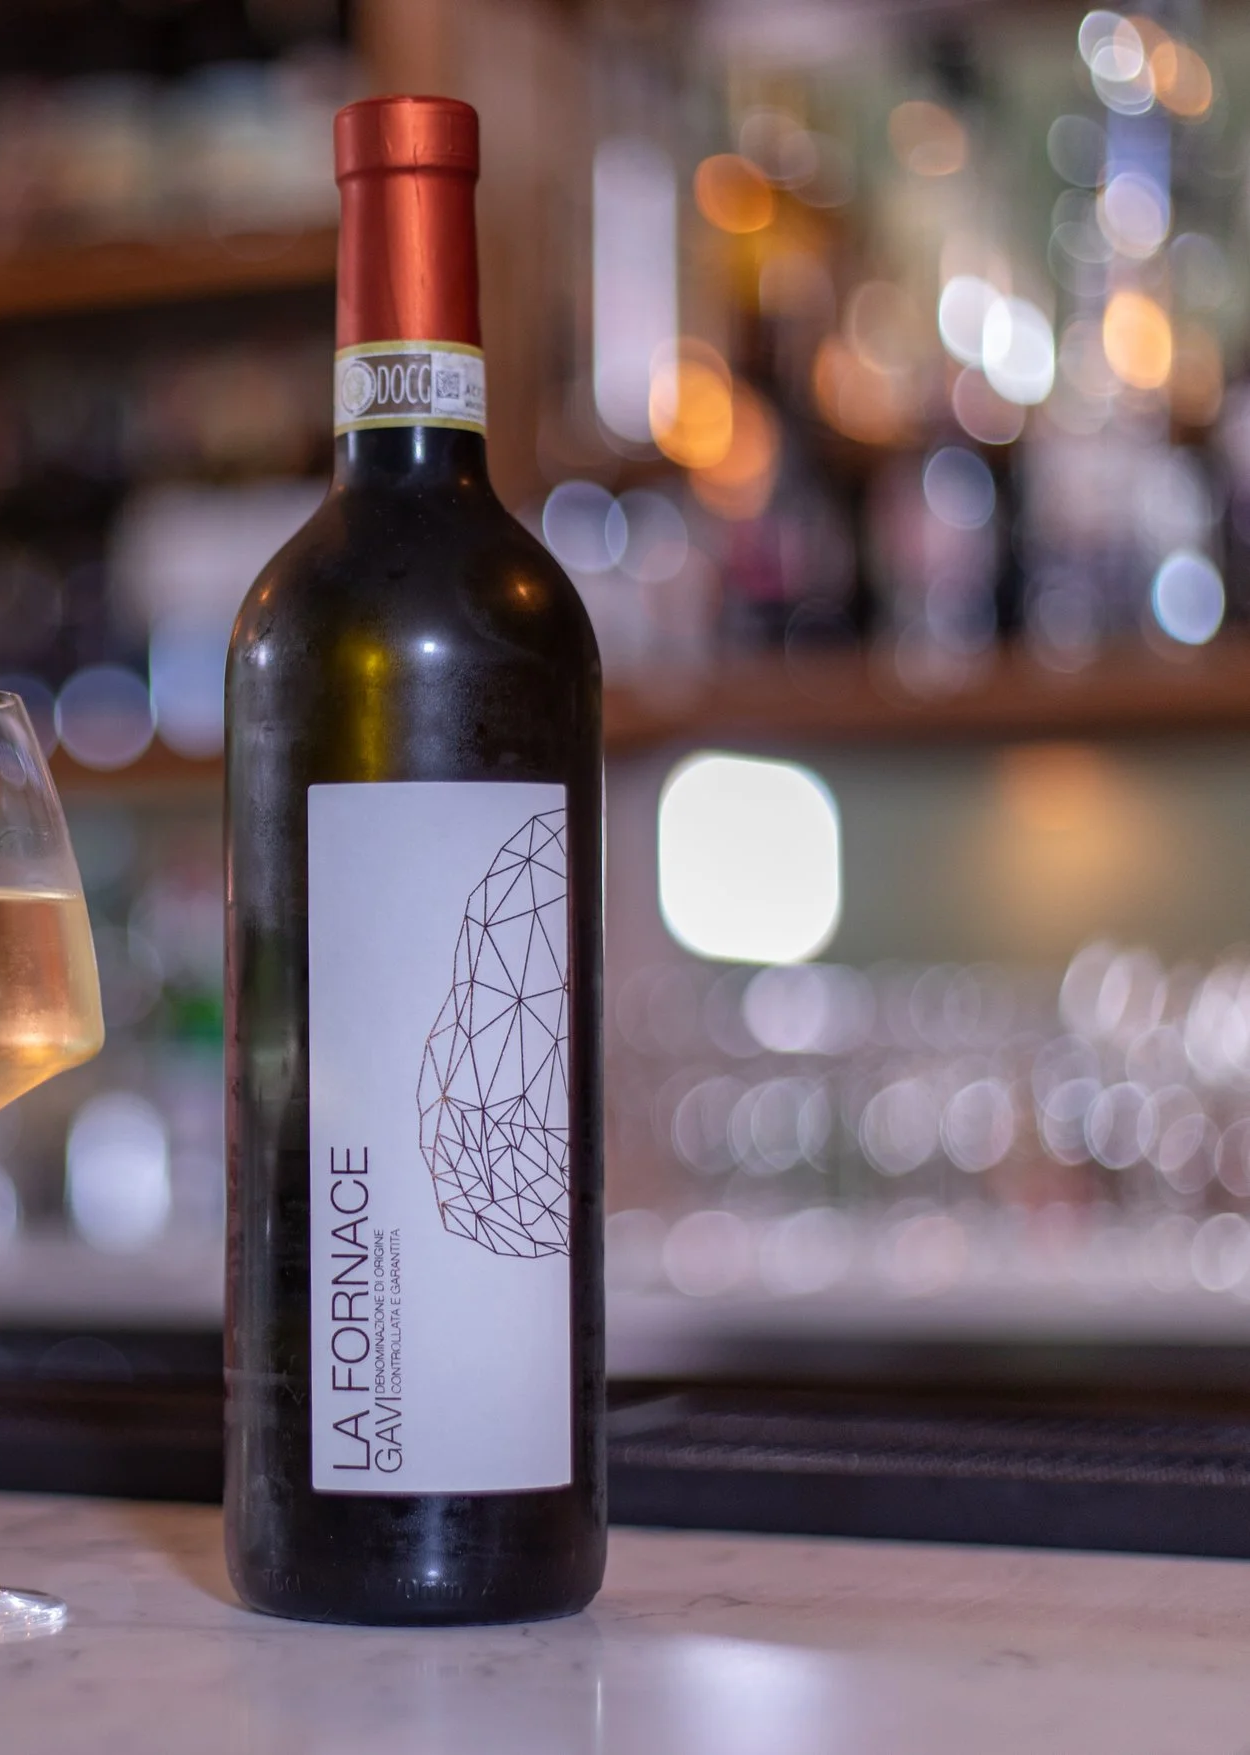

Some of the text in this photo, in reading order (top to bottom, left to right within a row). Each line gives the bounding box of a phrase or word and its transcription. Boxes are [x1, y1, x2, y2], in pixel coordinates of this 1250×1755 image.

[377, 364, 431, 404] DOCG
[330, 1147, 370, 1470] LA FORNACE
[373, 1228, 386, 1394] DENOMINAZIONE DI ORIGINE
[389, 1228, 402, 1394] CONTROLLATA E GARANTITA
[374, 1397, 403, 1473] GAVI
